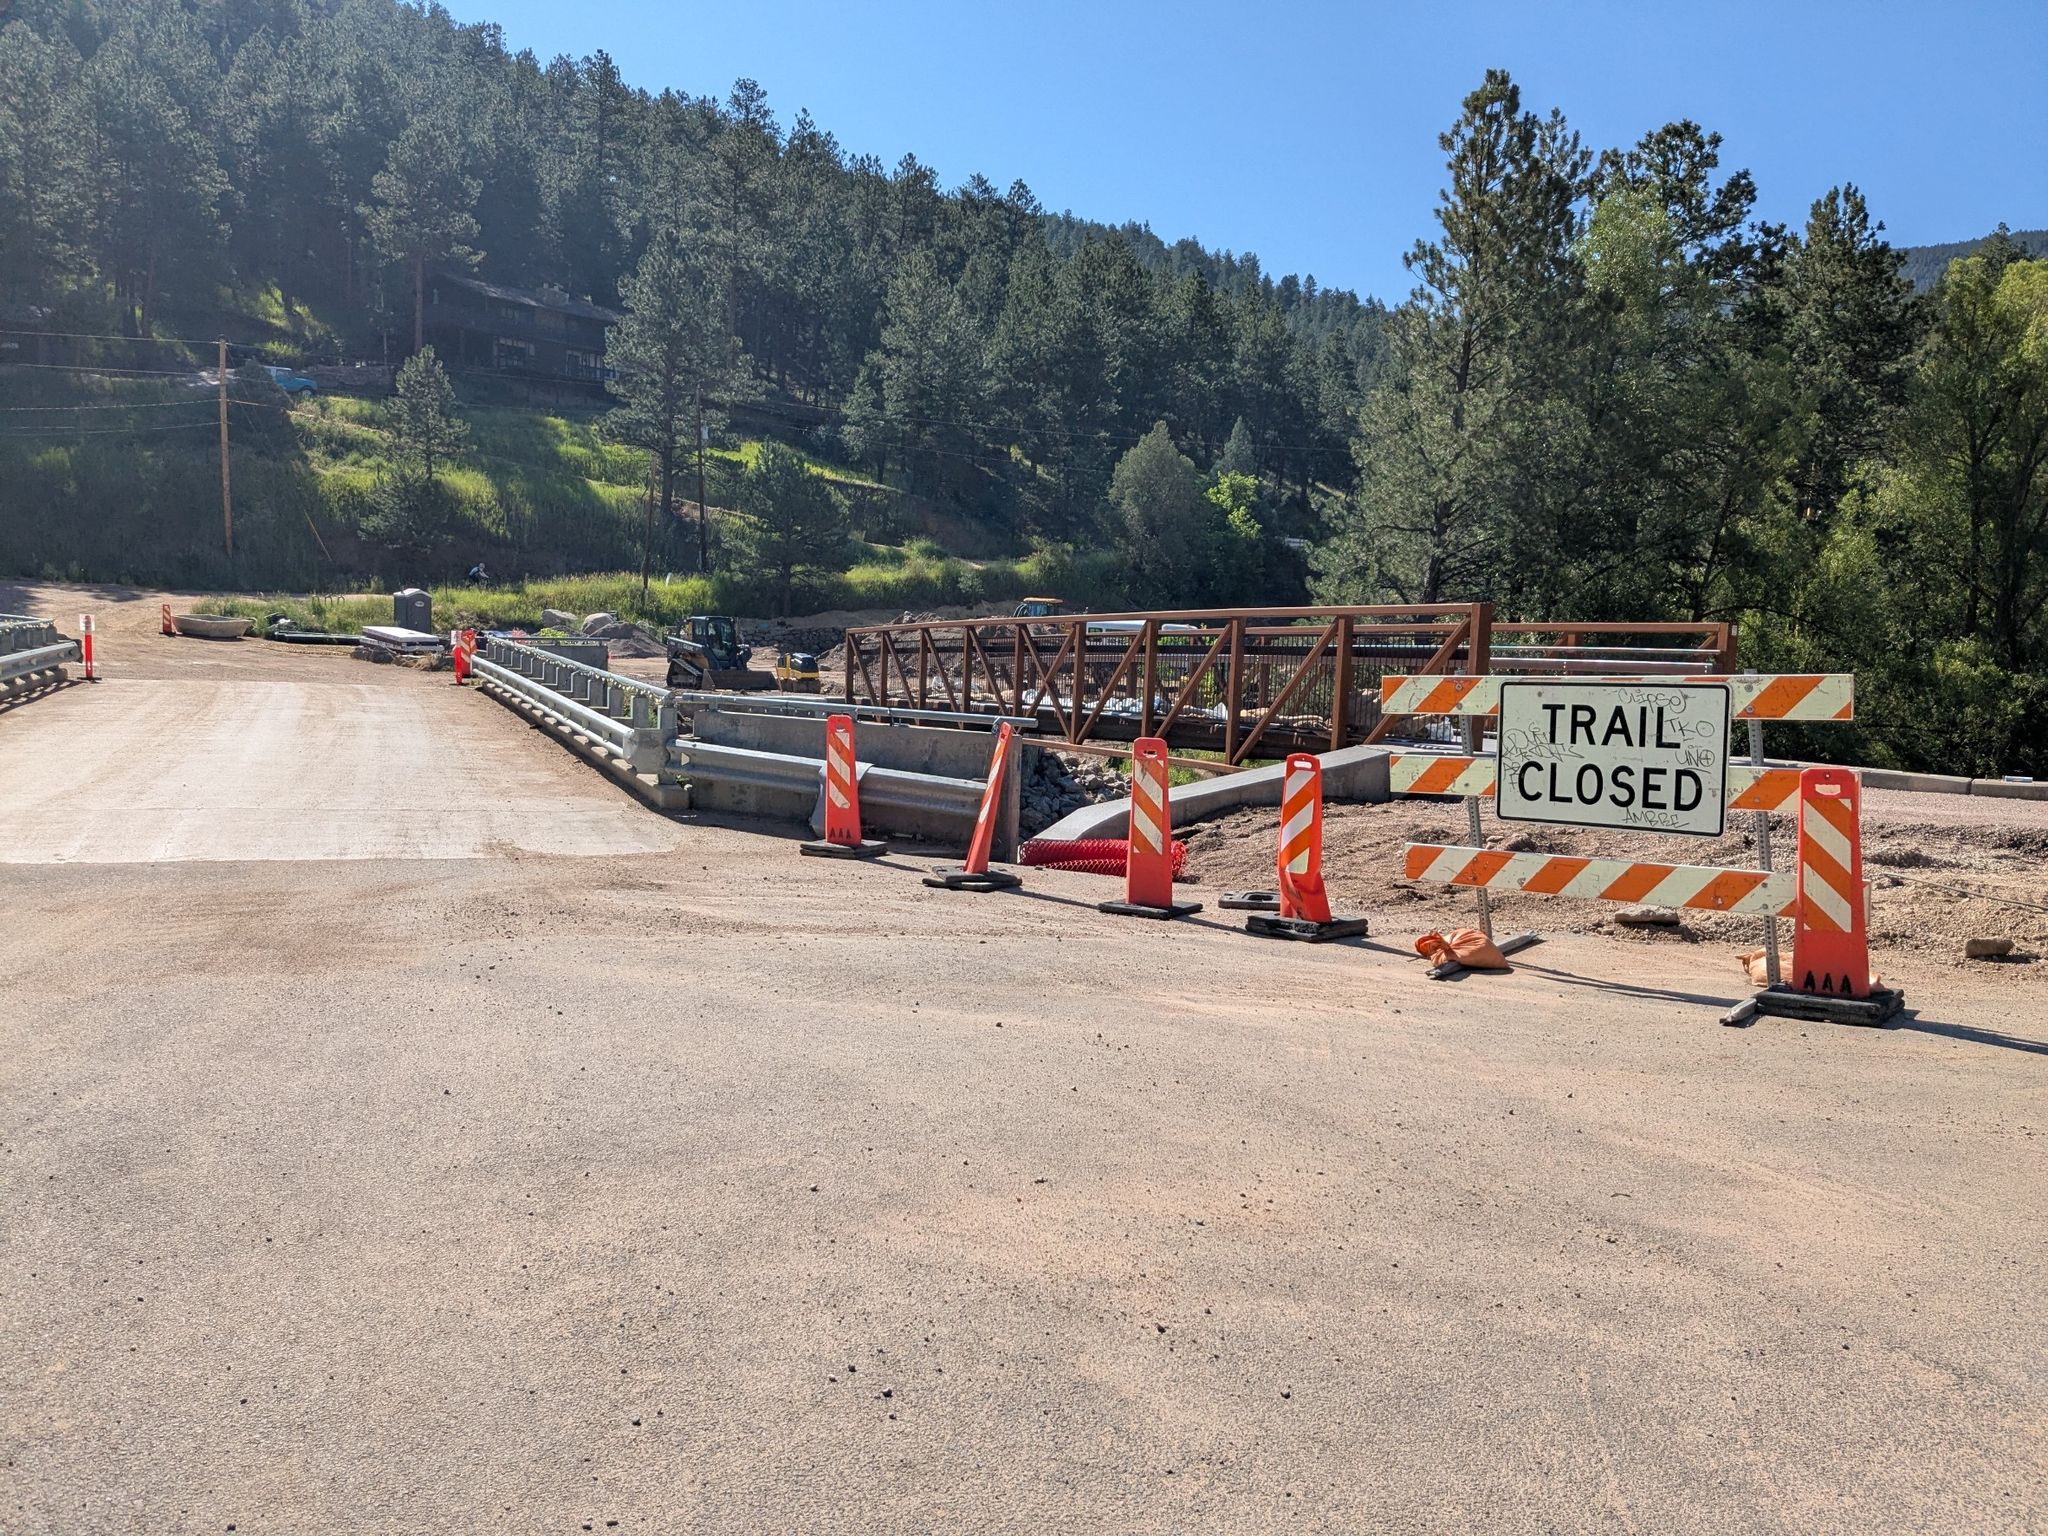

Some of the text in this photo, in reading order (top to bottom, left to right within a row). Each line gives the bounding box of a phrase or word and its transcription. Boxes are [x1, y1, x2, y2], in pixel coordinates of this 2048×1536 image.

[1542, 703, 1681, 749] TRAIL
[1518, 760, 1703, 812] CLOSED
[1803, 970, 1853, 994] AAA
